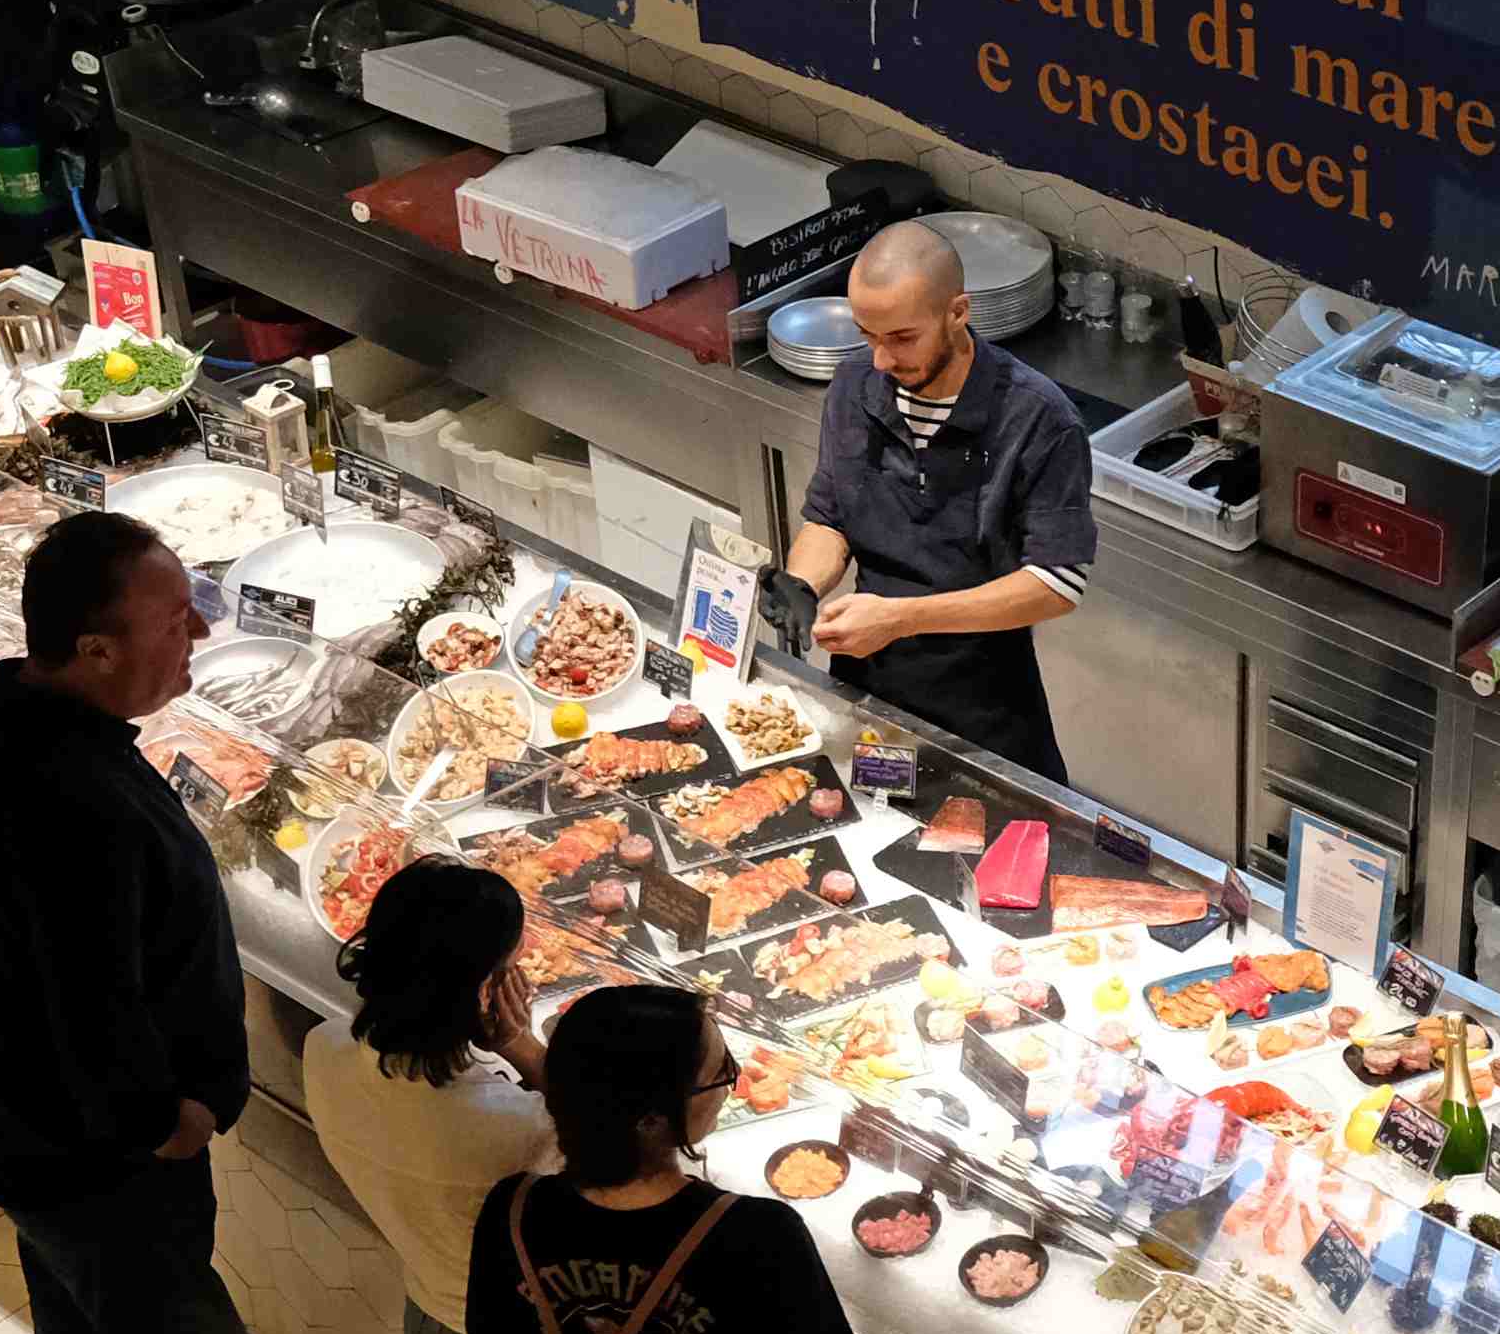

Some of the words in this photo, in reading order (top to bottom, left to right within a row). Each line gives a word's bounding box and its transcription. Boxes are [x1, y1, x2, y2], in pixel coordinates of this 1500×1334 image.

[976, 42, 1013, 94] e
[1037, 59, 1396, 230] crostacei.
[1290, 44, 1498, 157] mare
[461, 193, 485, 232] LA
[495, 213, 609, 296] VETRINA
